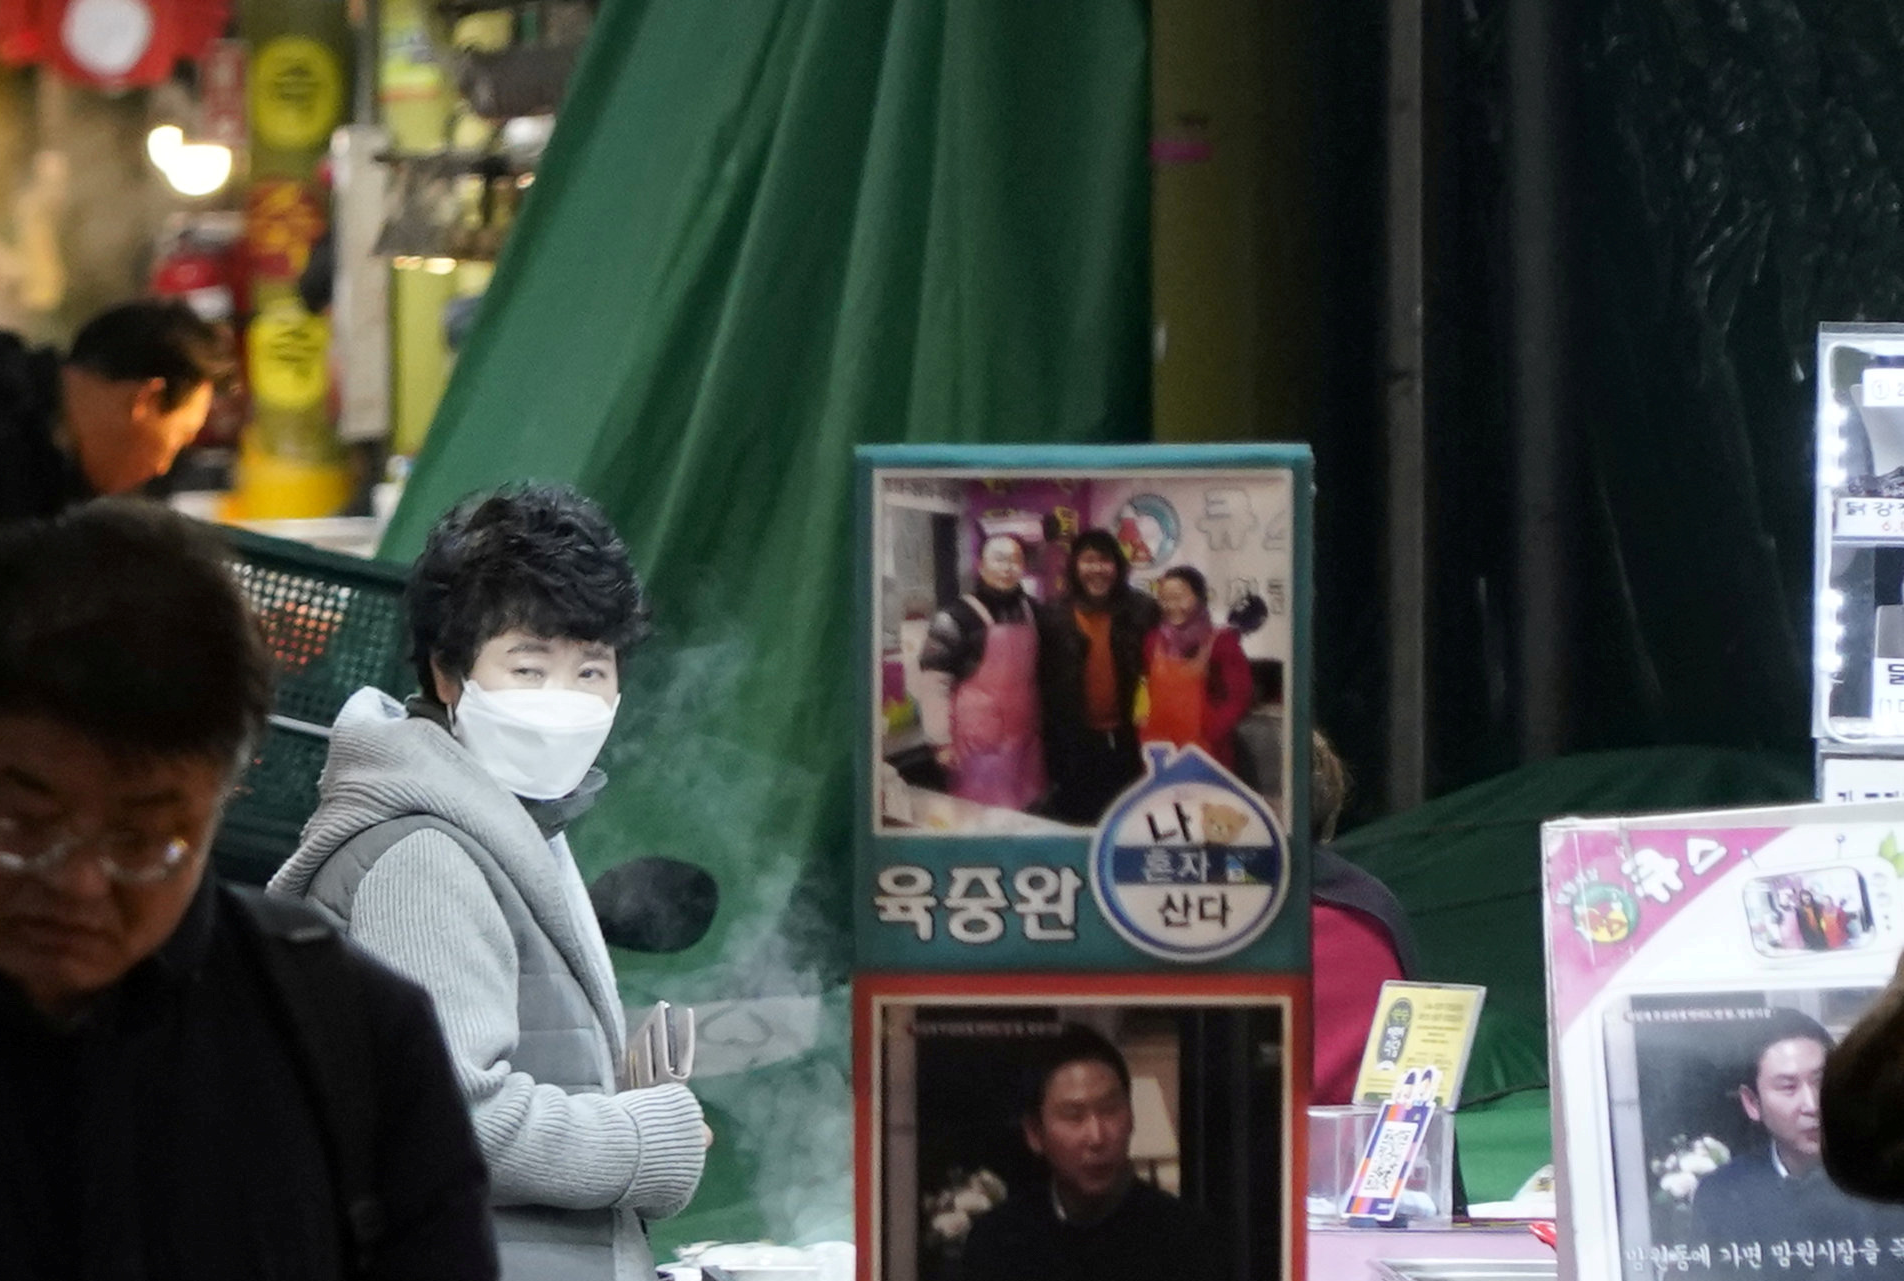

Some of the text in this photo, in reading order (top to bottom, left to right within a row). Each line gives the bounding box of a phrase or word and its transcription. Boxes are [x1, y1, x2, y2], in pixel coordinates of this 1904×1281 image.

[1145, 801, 1192, 844] 나
[1144, 847, 1211, 883] 혼자
[874, 864, 1085, 943] 육중완
[1158, 892, 1233, 929] 산다
[1625, 1243, 1711, 1271] 망원동에
[1720, 1240, 1762, 1270] 가면
[1771, 1237, 1881, 1268] 망원시장을
